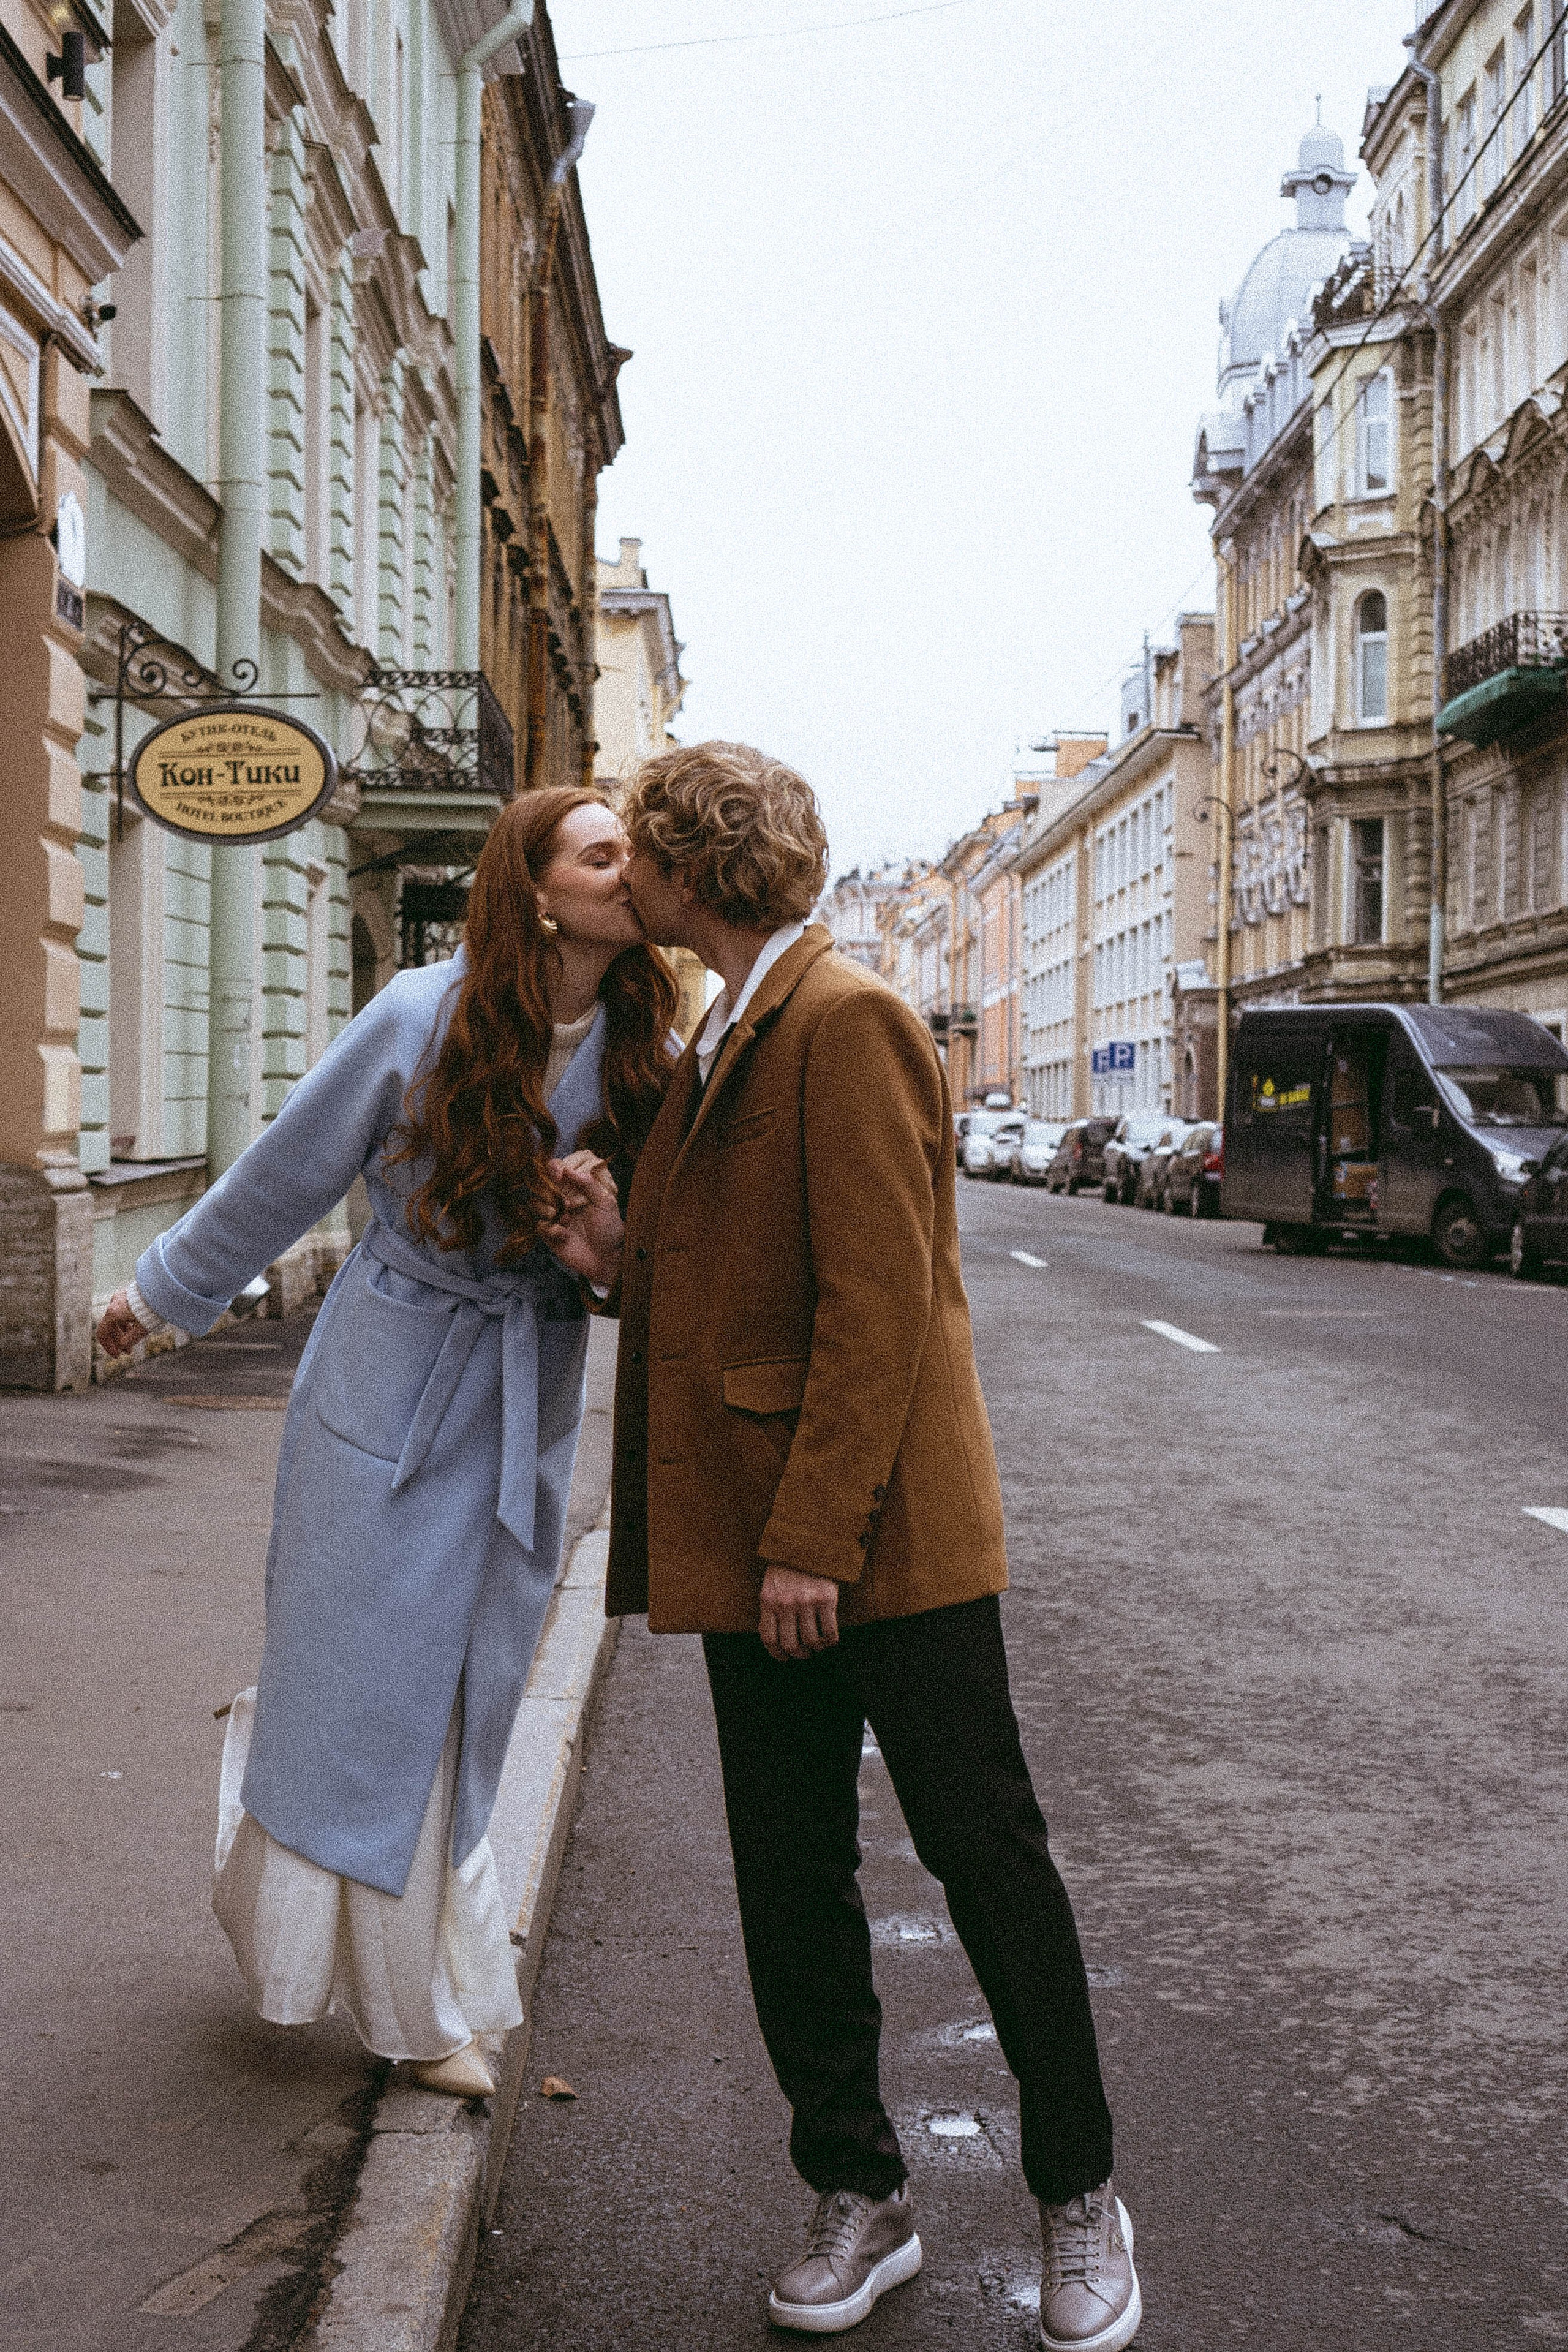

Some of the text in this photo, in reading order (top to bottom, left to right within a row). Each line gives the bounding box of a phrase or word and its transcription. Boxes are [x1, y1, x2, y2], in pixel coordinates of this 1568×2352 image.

[181, 724, 276, 742] БУТИК-ОТЕЛЬ
[159, 761, 300, 787] Кон-Тики
[176, 799, 285, 822] HOTEL BOUTIQUE
[1115, 1044, 1131, 1067] P
